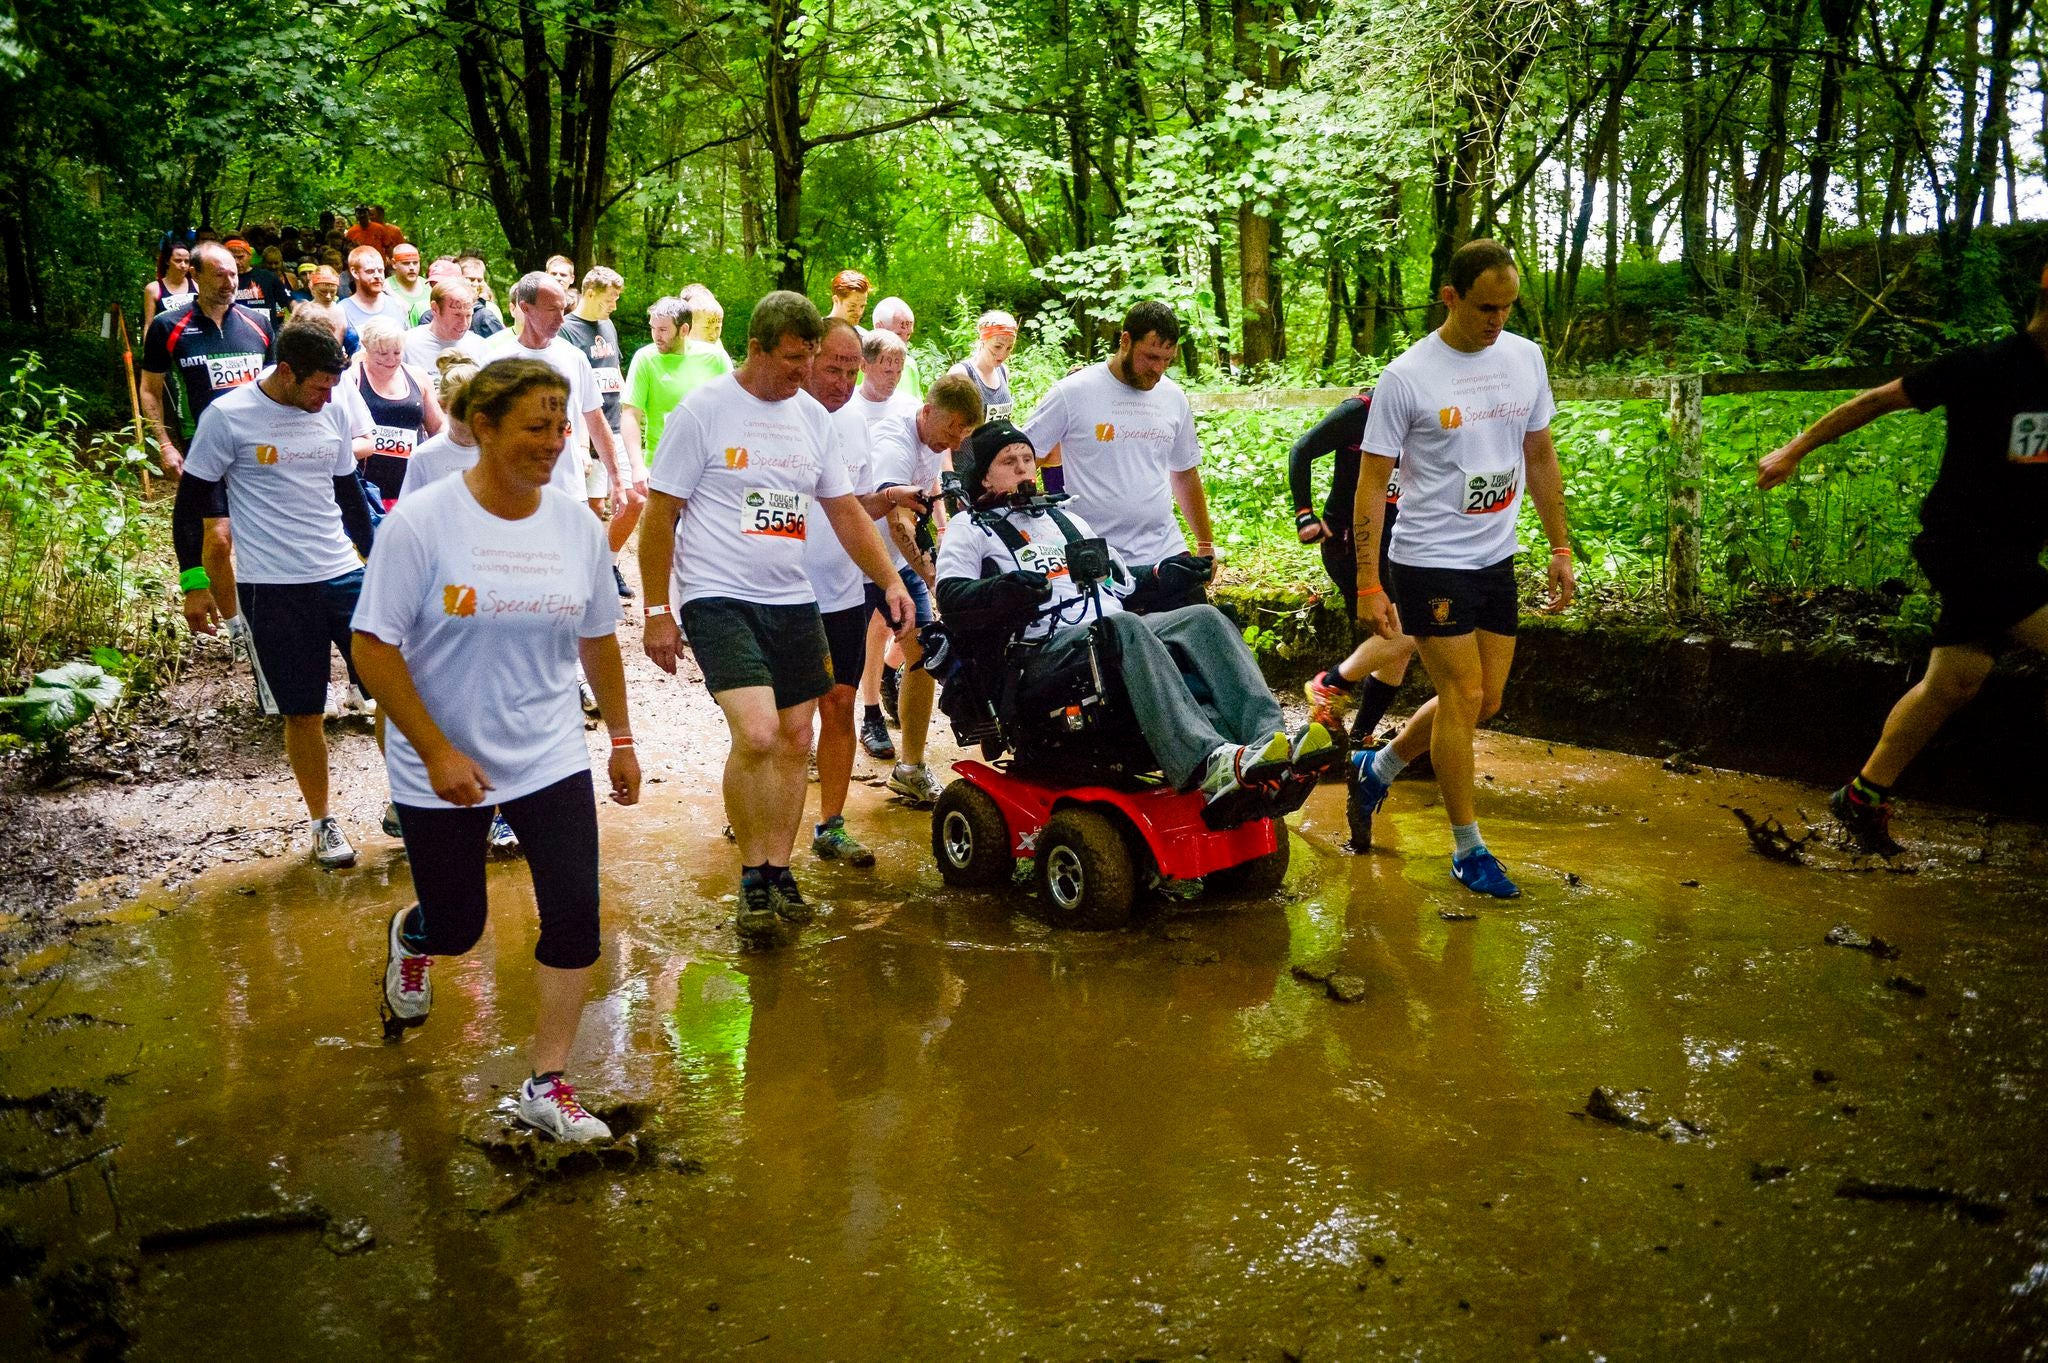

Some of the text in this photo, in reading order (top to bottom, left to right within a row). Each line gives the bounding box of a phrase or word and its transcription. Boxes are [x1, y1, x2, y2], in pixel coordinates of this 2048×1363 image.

[375, 437, 412, 454] 8261
[2018, 434, 2048, 456] 17
[769, 492, 794, 504] TOUGH
[472, 563, 564, 577] raising money for
